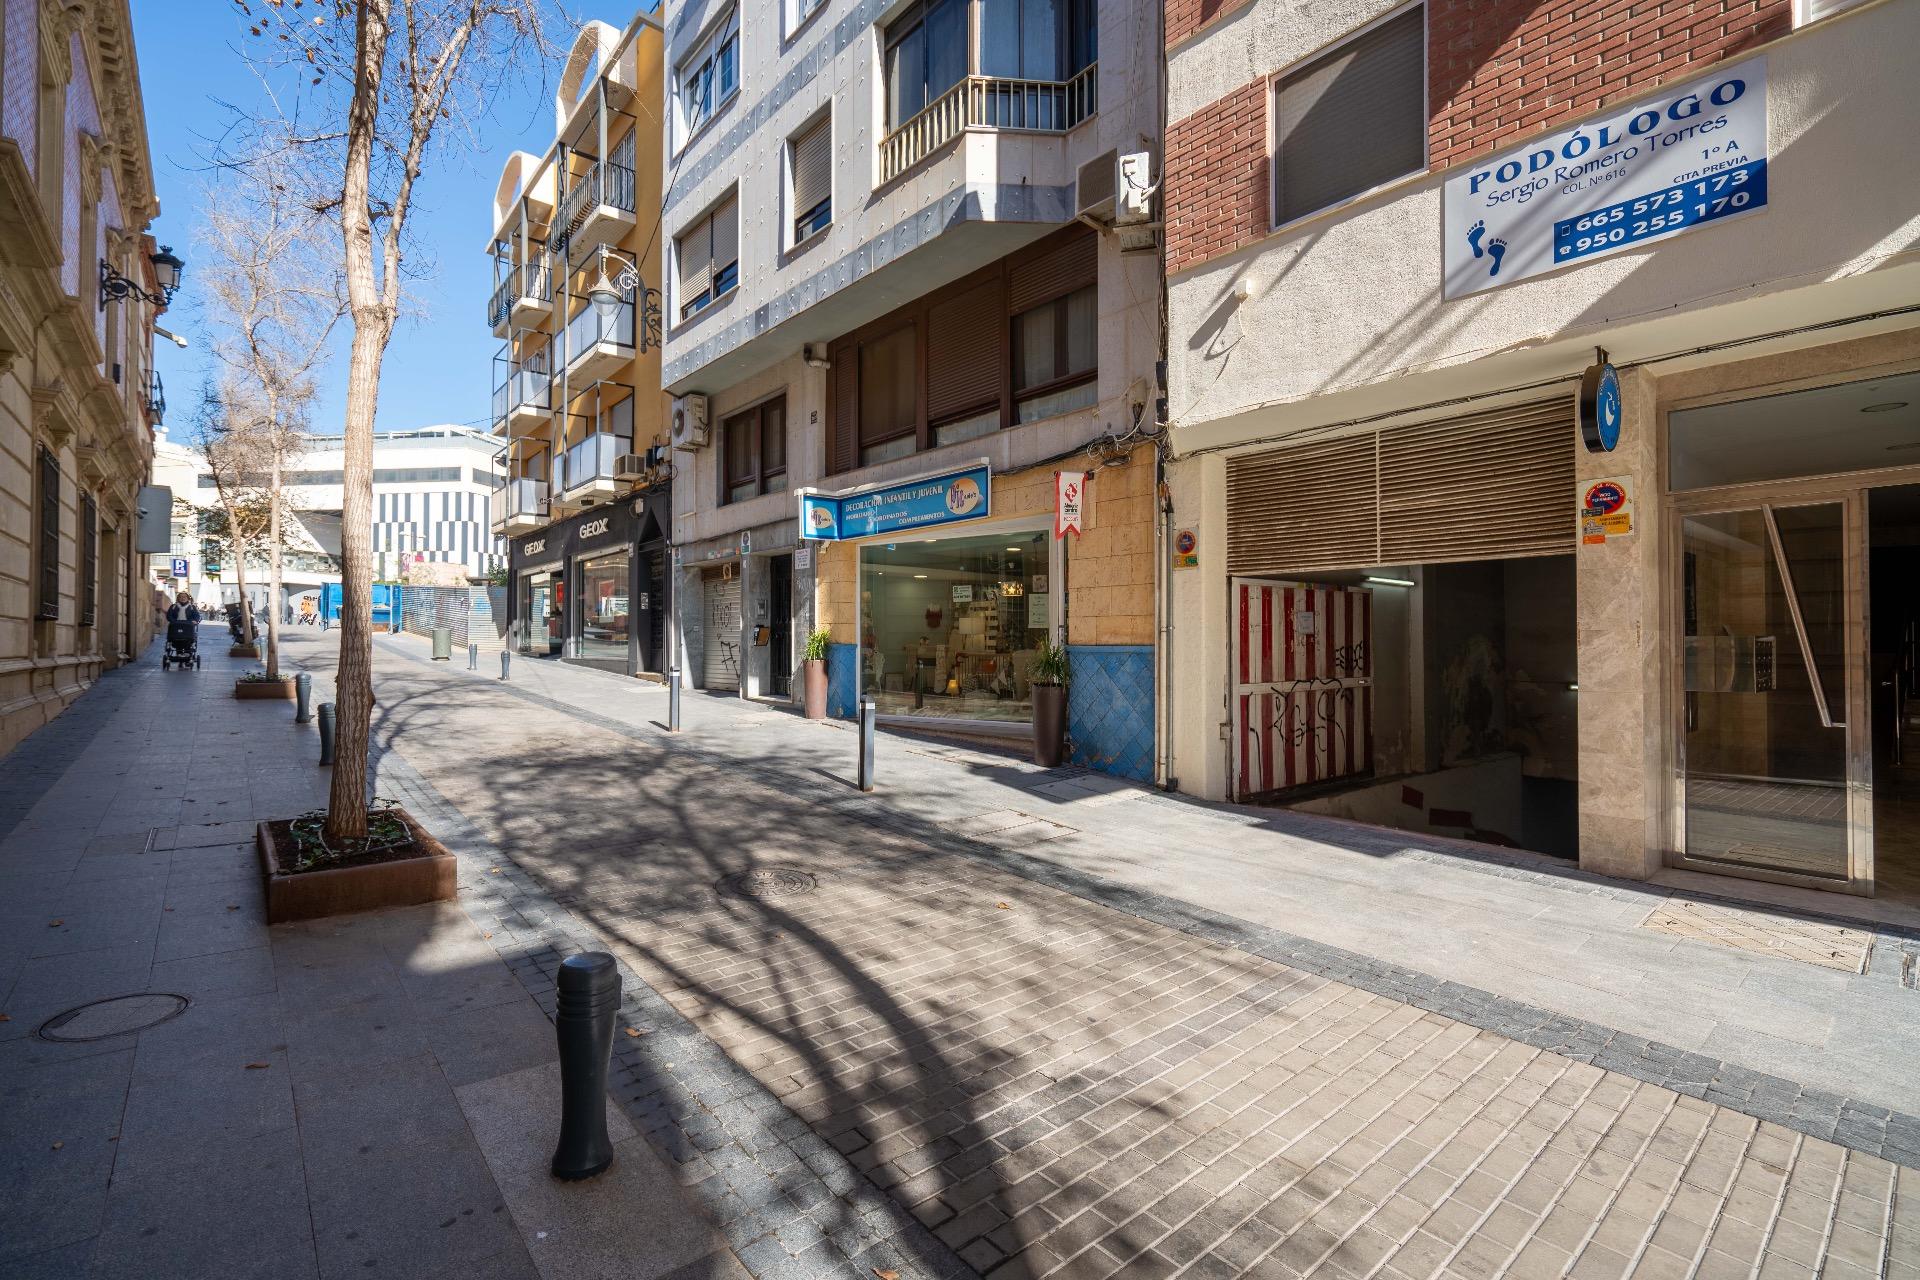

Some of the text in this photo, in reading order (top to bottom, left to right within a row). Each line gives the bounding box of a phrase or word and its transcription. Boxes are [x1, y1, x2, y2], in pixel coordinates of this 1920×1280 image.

[1469, 78, 1747, 196] PODÓLOGO
[1724, 139, 1740, 152] A
[1486, 114, 1729, 208] Sergio Romero Torres
[1673, 155, 1749, 184] CITA PREVIA
[1562, 166, 1627, 196] COL. Nº 616
[1575, 168, 1750, 232] 665 573 173
[1575, 190, 1751, 253] 950 255 170
[884, 491, 912, 504] INFANTIL
[918, 485, 944, 500] JUVENIL
[580, 518, 608, 539] GEOX
[524, 539, 545, 556] GEOX
